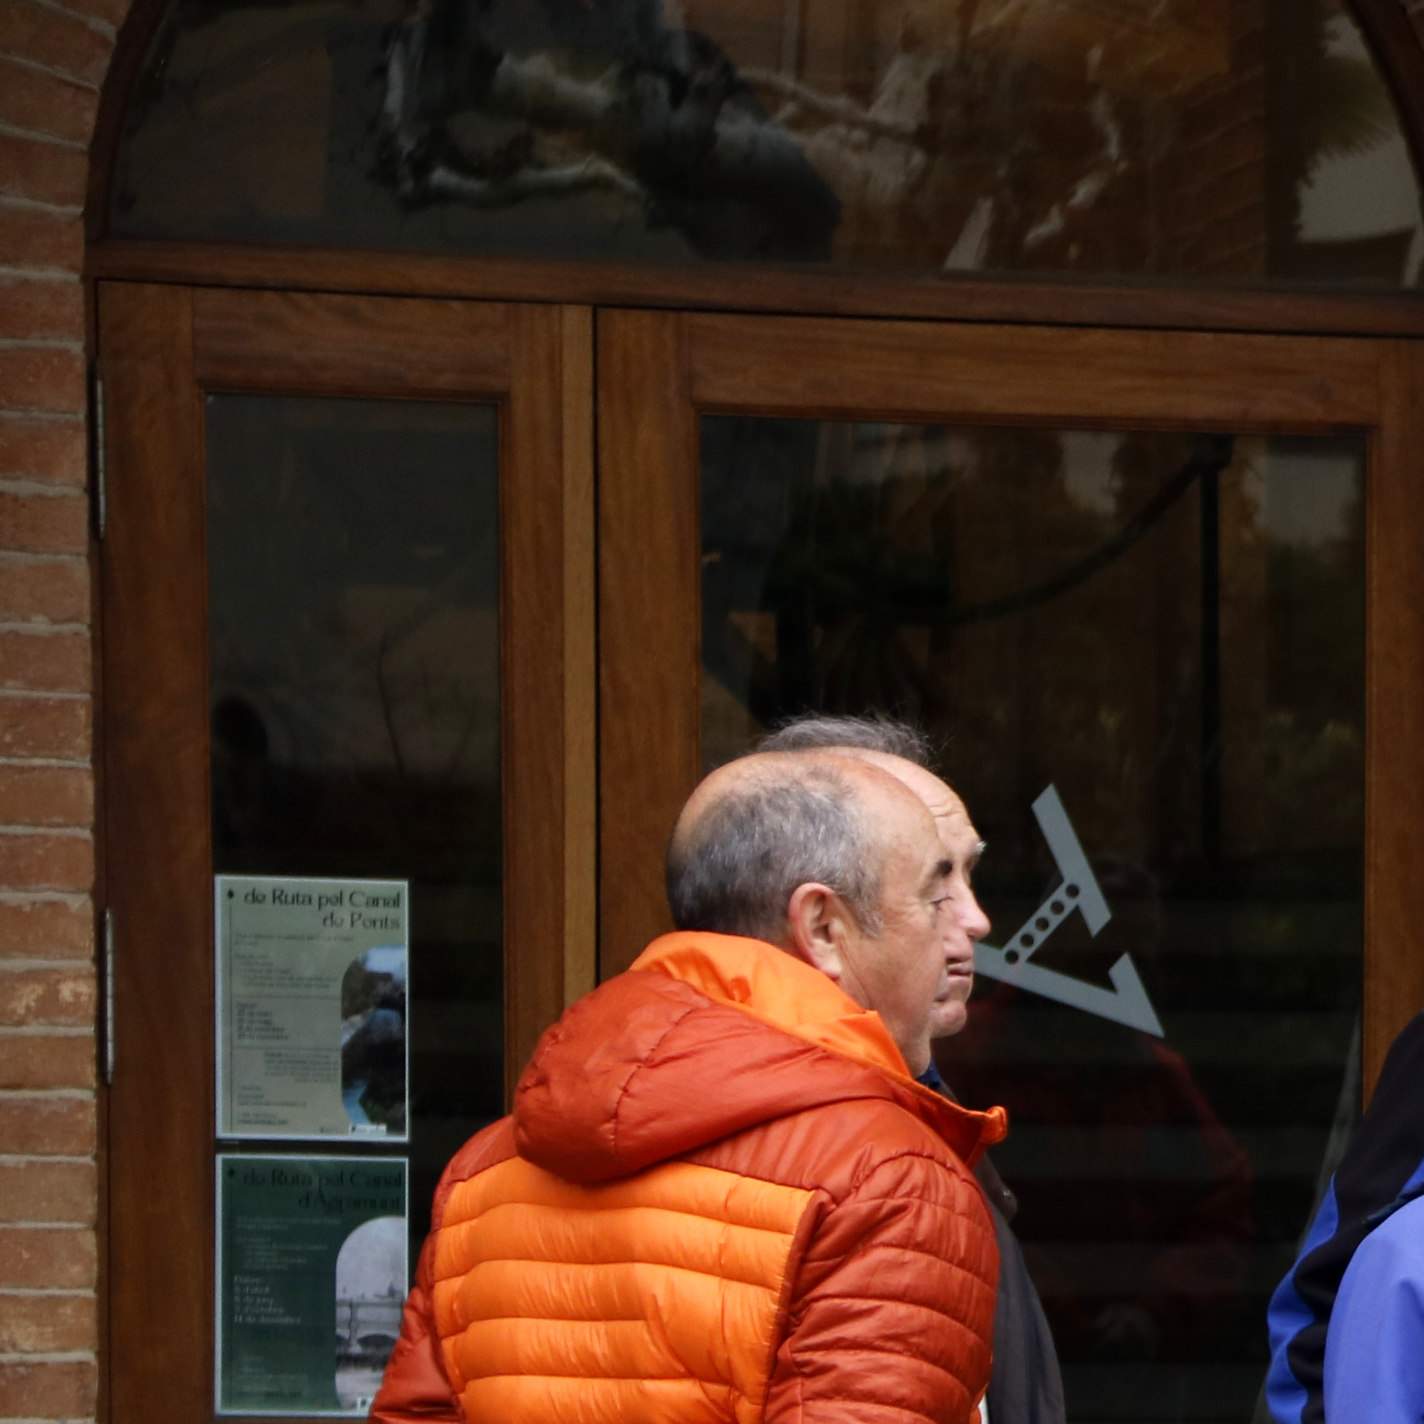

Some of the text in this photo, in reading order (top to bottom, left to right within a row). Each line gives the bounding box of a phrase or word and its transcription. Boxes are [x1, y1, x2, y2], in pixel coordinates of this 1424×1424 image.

[272, 889, 312, 906] Ruta
[349, 890, 400, 908] Canal
[351, 912, 400, 929] Ponts
